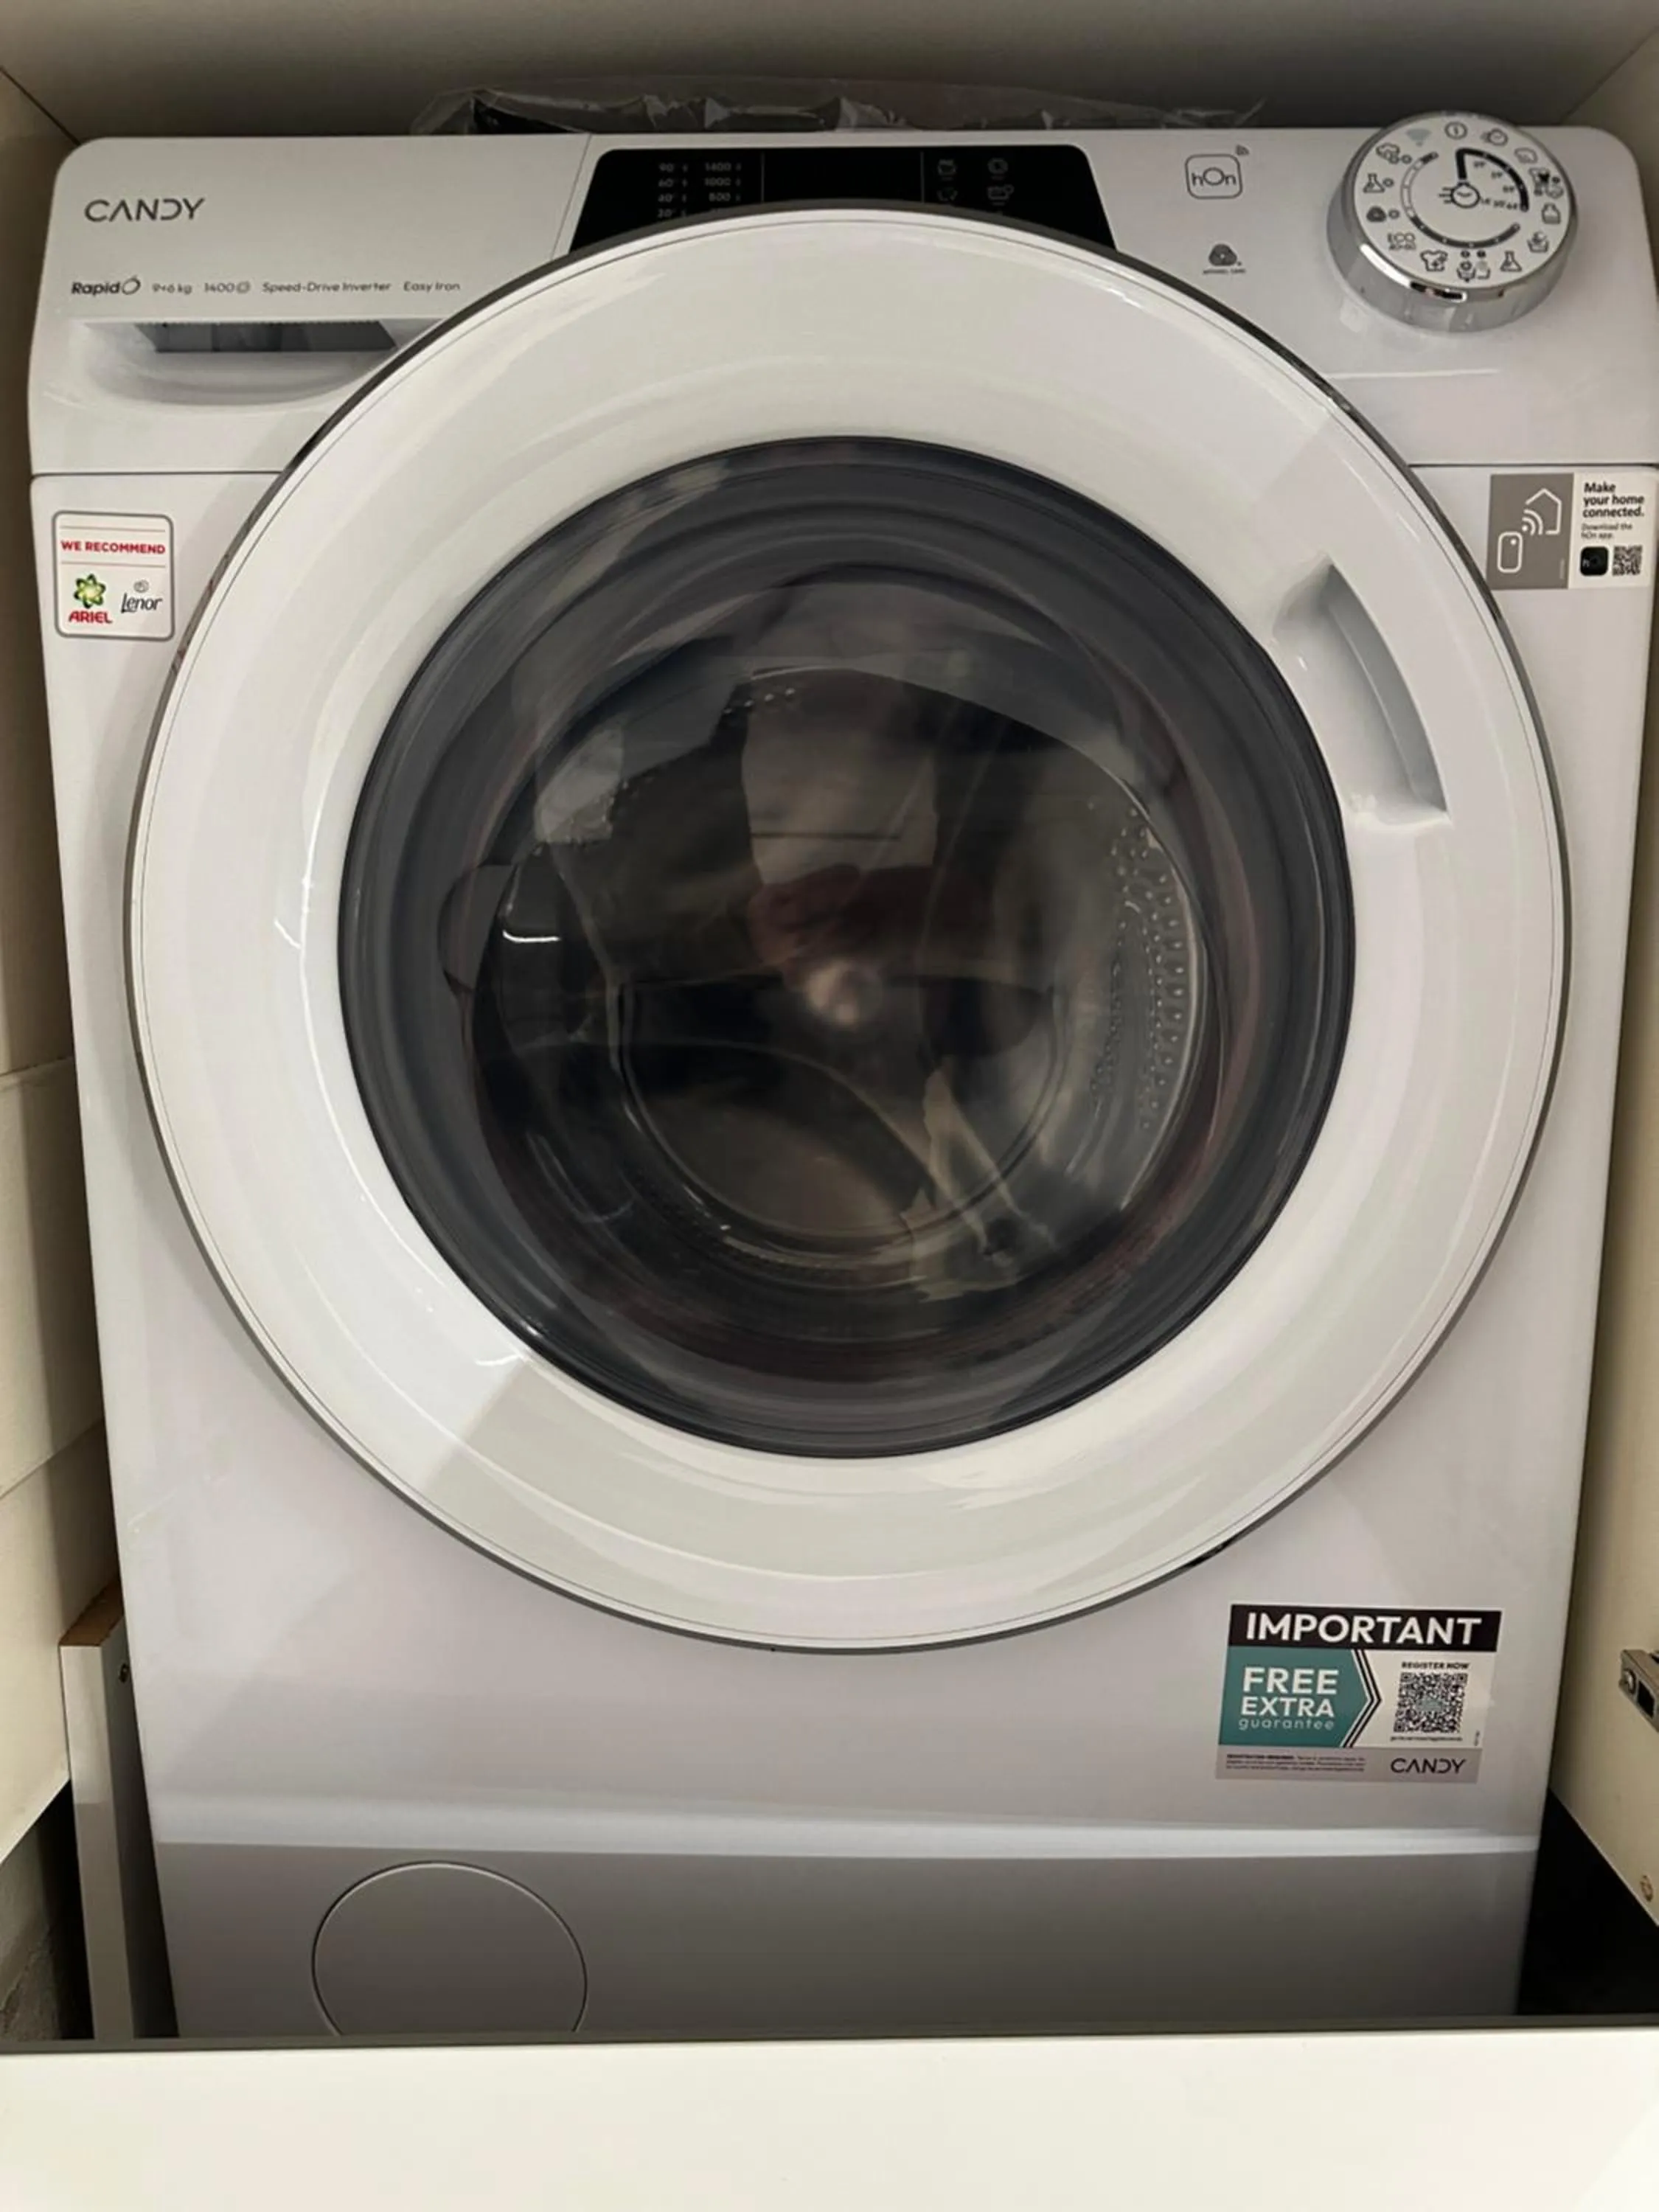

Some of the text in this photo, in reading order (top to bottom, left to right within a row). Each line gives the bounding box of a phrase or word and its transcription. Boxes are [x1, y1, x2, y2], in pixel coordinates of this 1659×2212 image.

[1192, 167, 1237, 187] hOn
[84, 198, 205, 223] CANDY
[1584, 482, 1615, 493] Make
[1583, 494, 1645, 507] your home
[1582, 507, 1644, 518] connected.
[60, 540, 166, 554] WE RECOMMEND
[121, 593, 163, 613] Lenor
[68, 611, 113, 623] ARIEL
[1245, 1612, 1482, 1645] IMPORTANT
[1401, 1661, 1470, 1670] REGISTER NOW
[1242, 1666, 1340, 1695] FREE
[1240, 1697, 1335, 1717] EXTRA
[1237, 1718, 1335, 1731] guarantee
[1390, 1758, 1467, 1775] CANDY
